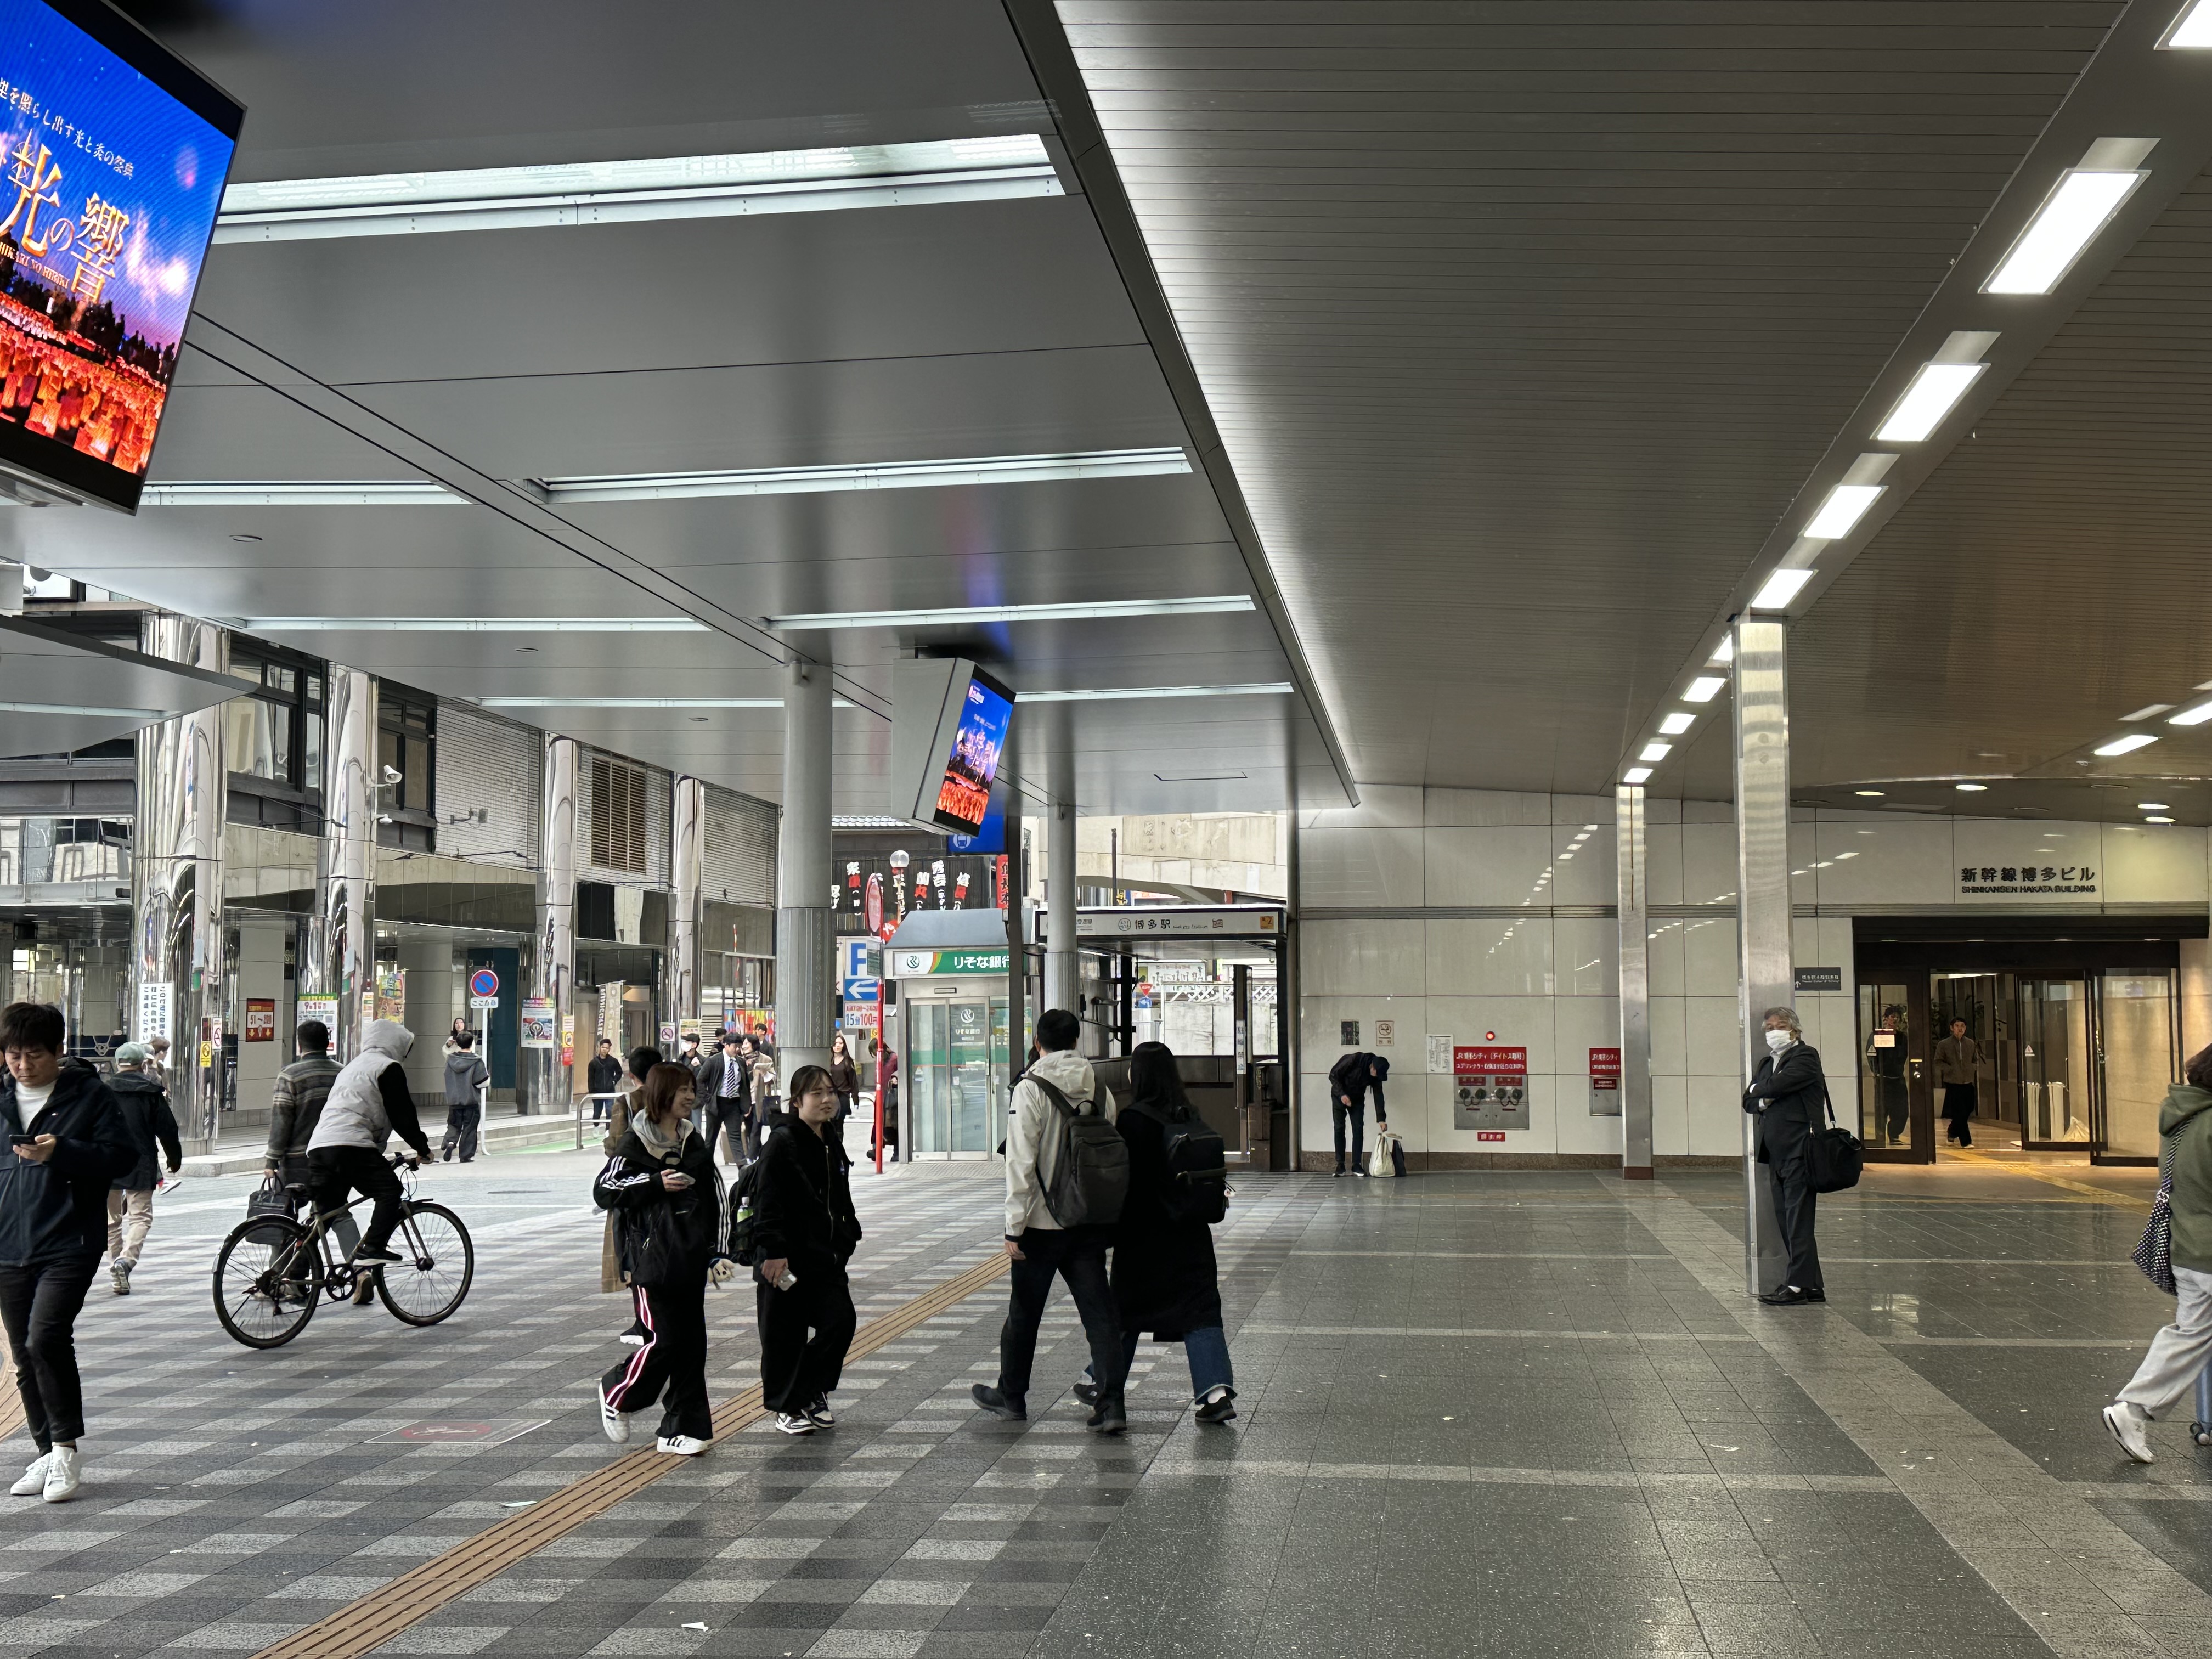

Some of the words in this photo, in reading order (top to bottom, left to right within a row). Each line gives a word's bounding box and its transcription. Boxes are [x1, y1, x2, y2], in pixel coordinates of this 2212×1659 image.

[1961, 867, 2095, 882] 新幹線博多ビル
[2055, 885, 2096, 893] BUILDING
